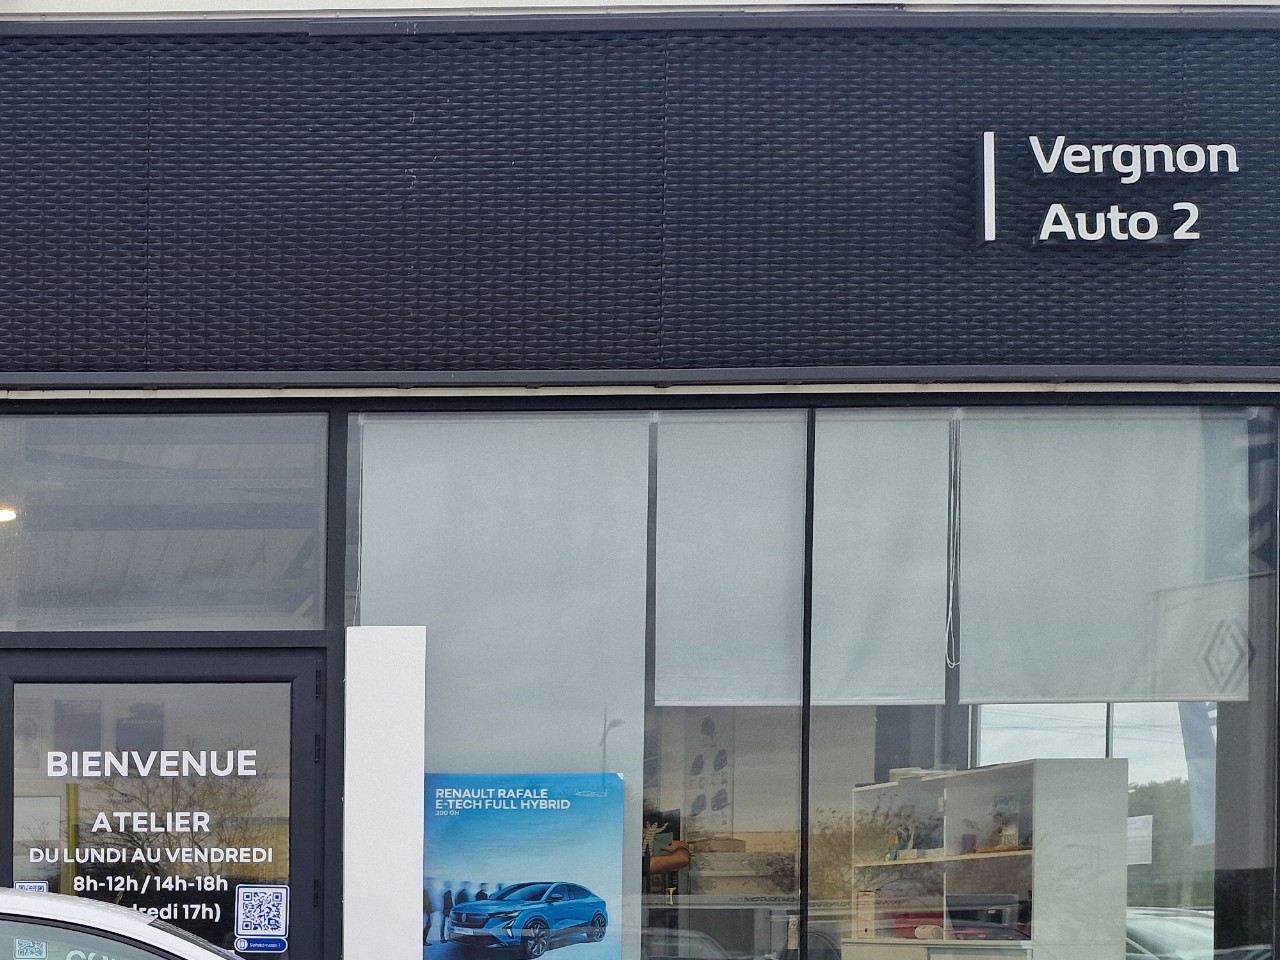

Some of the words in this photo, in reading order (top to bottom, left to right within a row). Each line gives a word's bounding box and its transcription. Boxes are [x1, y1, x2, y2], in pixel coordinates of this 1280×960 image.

[1028, 135, 1240, 184] Vergnon
[1039, 202, 1159, 241] Auto
[1173, 201, 1201, 240] 2
[47, 750, 257, 777] BIENVENUE
[435, 788, 496, 799] RENAULT
[497, 788, 549, 799] RAFALE
[435, 799, 482, 810] E-TECH
[484, 799, 518, 810] FULL
[520, 799, 571, 810] HYBRID
[91, 811, 210, 832] ATELIER
[29, 847, 59, 863] DU
[63, 847, 127, 863] LUNDI
[131, 847, 161, 863] AU
[165, 847, 273, 863] VENDREDI
[73, 875, 139, 892] 8h-12h
[153, 875, 229, 892] 14h-18h
[182, 903, 221, 922] 17h)
